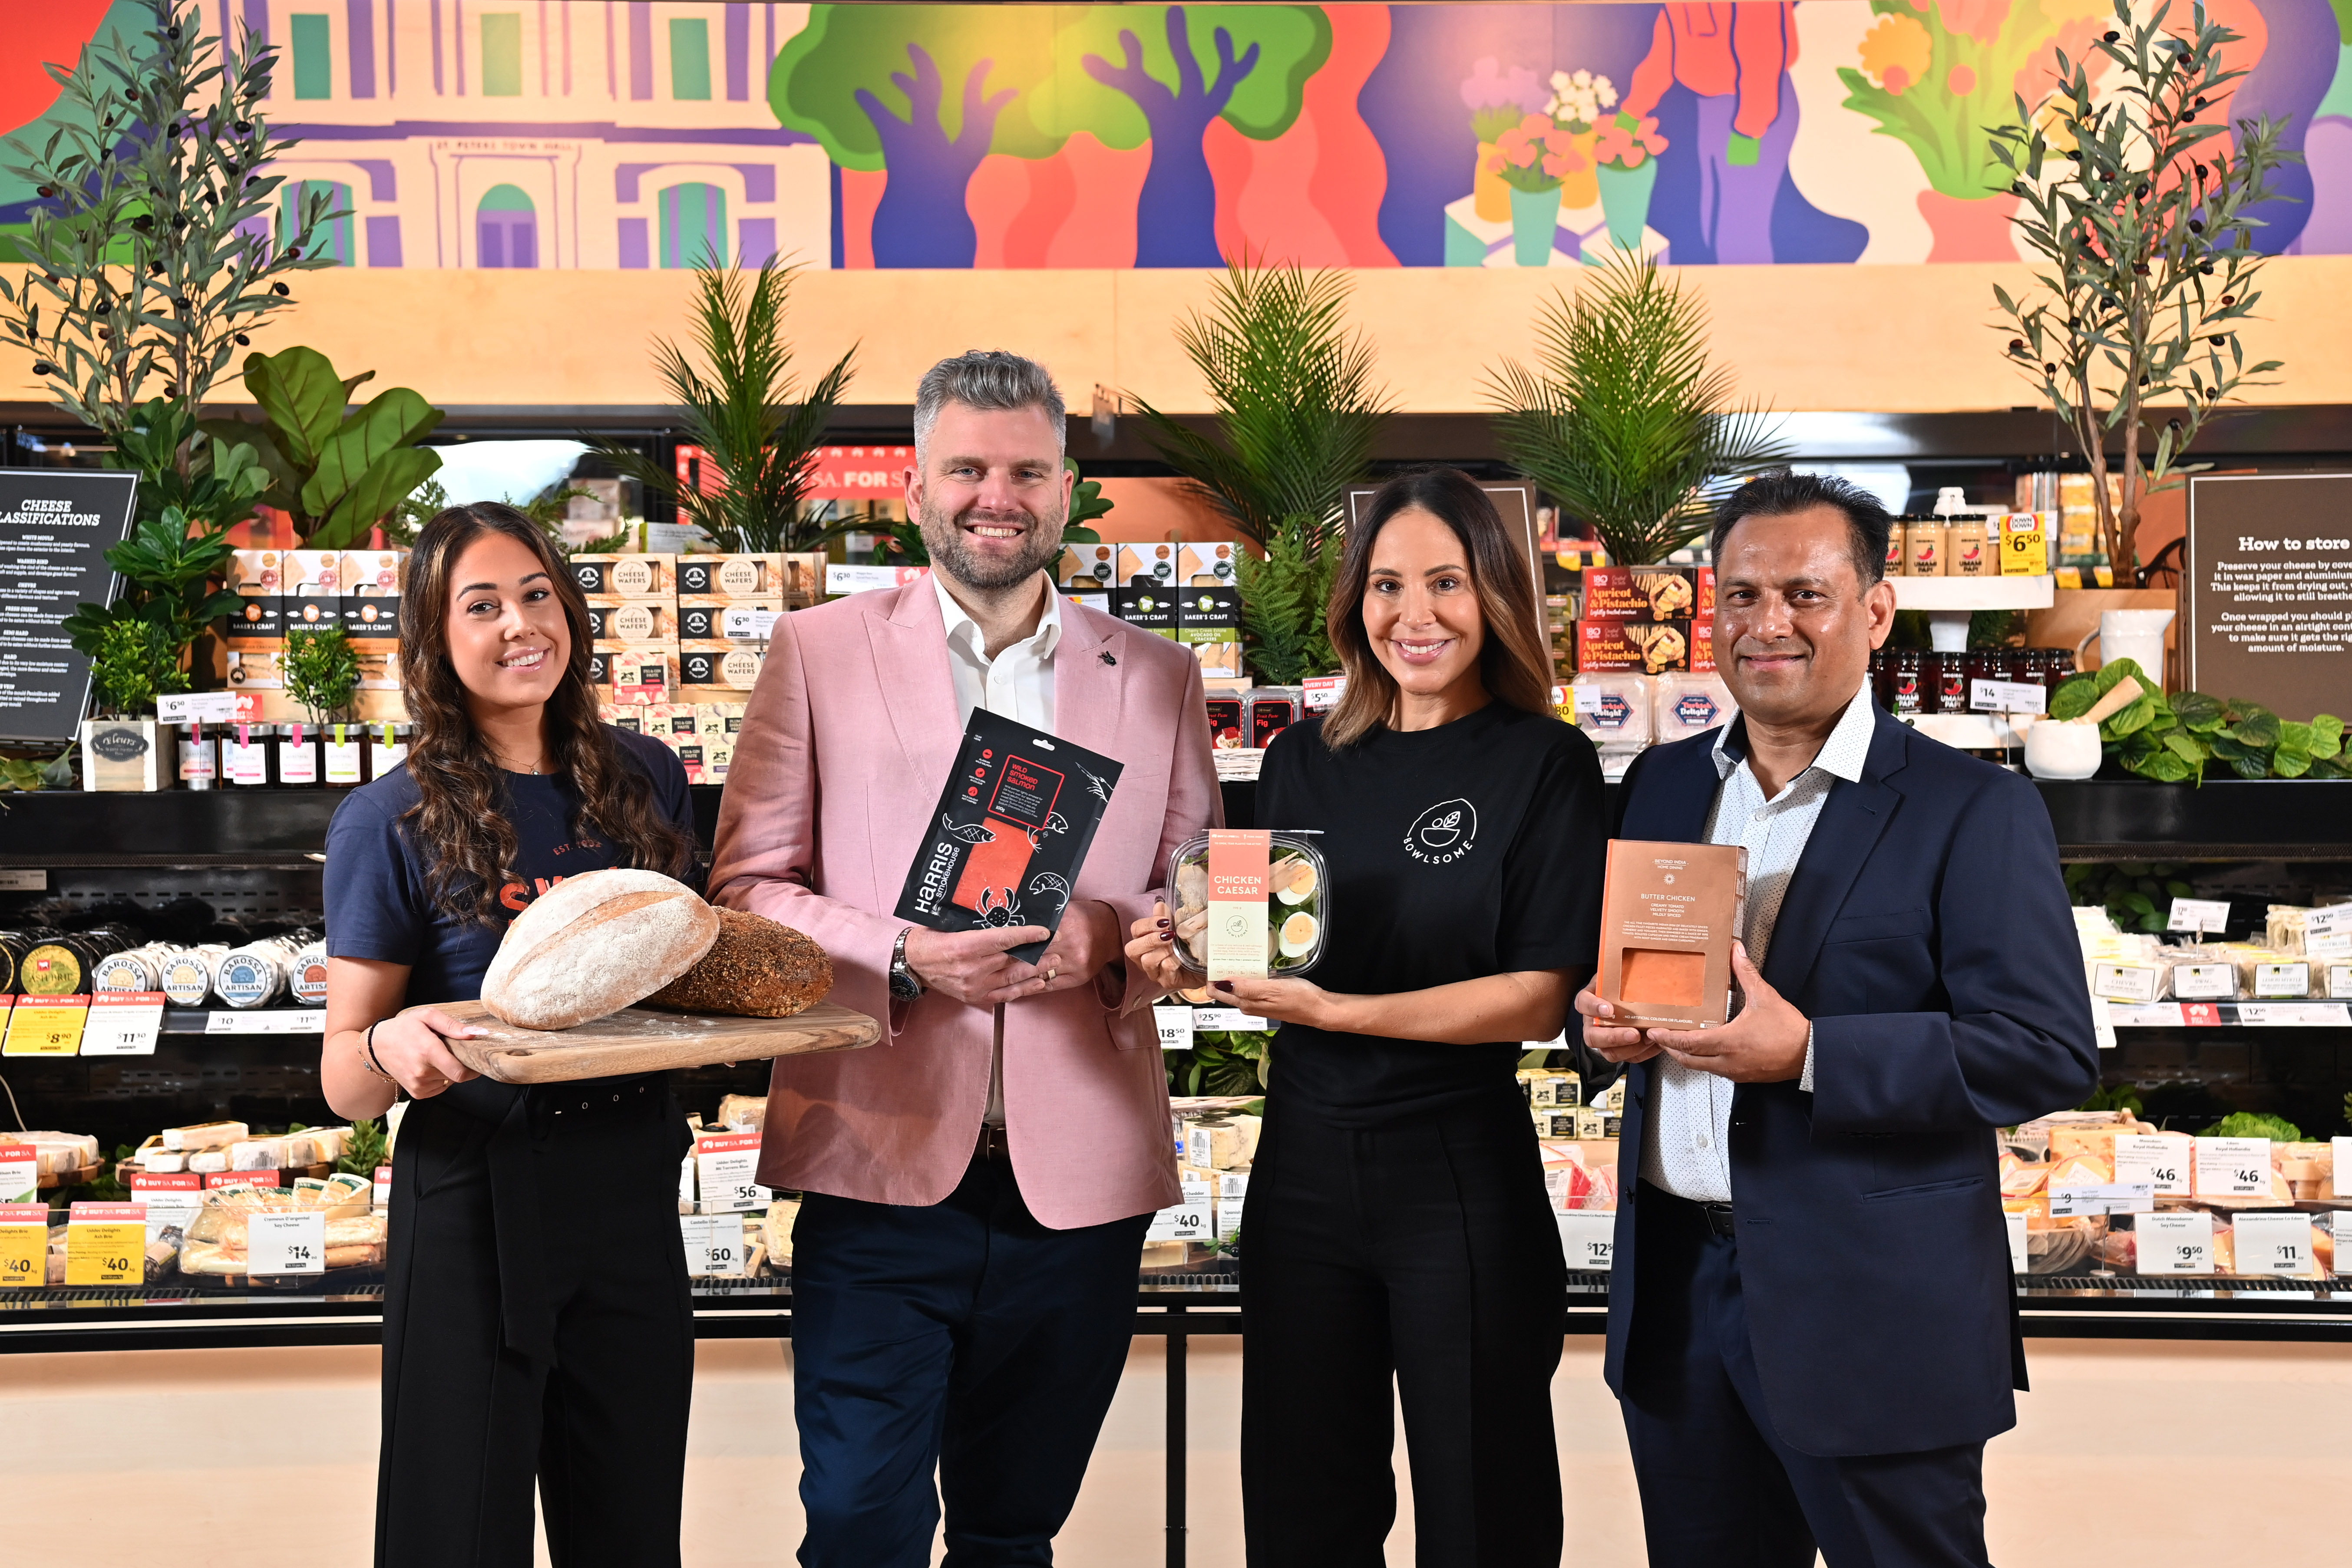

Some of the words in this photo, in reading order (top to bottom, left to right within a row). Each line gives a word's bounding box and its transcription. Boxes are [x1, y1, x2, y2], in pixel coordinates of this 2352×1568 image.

[845, 471, 889, 488] FOR
[21, 499, 73, 512] CHEESE
[0, 512, 101, 526] LASSIFICATIONS
[2238, 537, 2279, 551] How
[2283, 538, 2302, 551] to
[2306, 537, 2350, 550] store
[2217, 561, 2258, 571] Preserve
[2260, 562, 2282, 572] your
[2283, 560, 2316, 570] cheese
[2318, 560, 2330, 571] by
[1593, 574, 1609, 584] 180
[2214, 572, 2222, 581] it
[2223, 572, 2233, 581] in
[2256, 573, 2283, 582] paper
[2284, 571, 2302, 580] and
[2210, 582, 2232, 591] This
[2233, 582, 2260, 592] keeps
[2262, 582, 2270, 591] it
[2272, 581, 2295, 591] from
[2296, 581, 2328, 592] drying
[2329, 582, 2348, 591] out,
[1590, 588, 1632, 600] Apricot
[2233, 592, 2274, 603] allowing
[2275, 592, 2283, 601] it
[2285, 593, 2295, 601] to
[2297, 591, 2316, 601] still
[1590, 608, 1606, 617] Lightly
[2221, 612, 2246, 621] Once
[2248, 611, 2289, 622] wrapped
[2290, 613, 2309, 622] you
[2310, 611, 2343, 621] should
[2211, 624, 2233, 634] your
[2234, 622, 2267, 631] cheese
[2269, 622, 2279, 631] in
[2295, 621, 2331, 633] airtight
[2228, 634, 2240, 642] to
[2241, 633, 2266, 642] make
[2291, 633, 2299, 642] it
[2300, 633, 2321, 644] gets
[2322, 632, 2339, 641] the
[2248, 644, 2285, 652] amount
[2286, 643, 2297, 652] of
[2299, 643, 2345, 652] moisture.
[1680, 708, 1709, 716] Delight
[1256, 719, 1268, 728] Fig
[1011, 763, 1028, 774] WILD
[1403, 837, 1473, 865] BOWLSOME
[1214, 875, 1262, 885] CHICKEN
[1217, 886, 1258, 895] CAESAR
[1226, 929, 1248, 938] BOWLSOME
[224, 957, 262, 976] BAROSSA
[734, 1185, 756, 1198] $56
[1174, 1214, 1200, 1228] $40
[102, 1257, 129, 1271] $40
